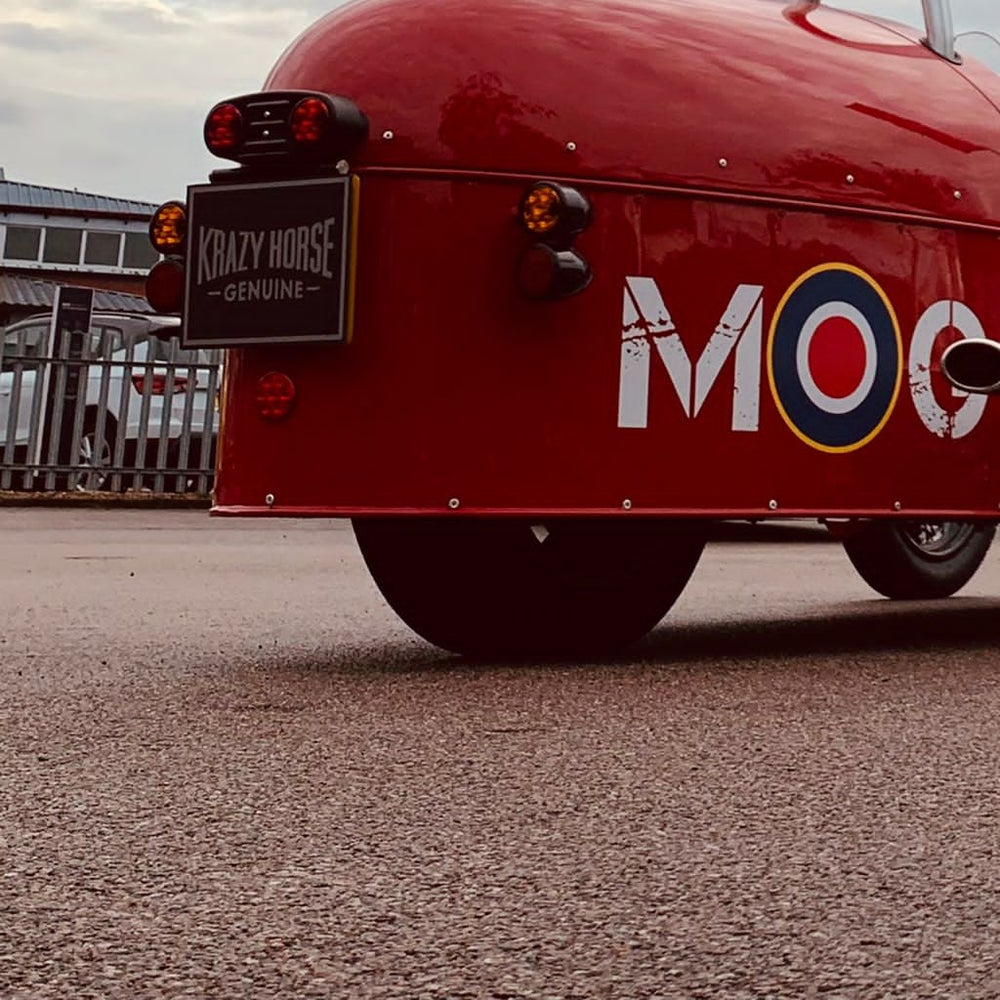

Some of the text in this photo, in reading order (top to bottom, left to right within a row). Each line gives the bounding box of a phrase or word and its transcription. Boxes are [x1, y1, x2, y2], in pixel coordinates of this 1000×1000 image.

[197, 217, 335, 286] KRAZY HORSE
[224, 278, 304, 301] GENUINE
